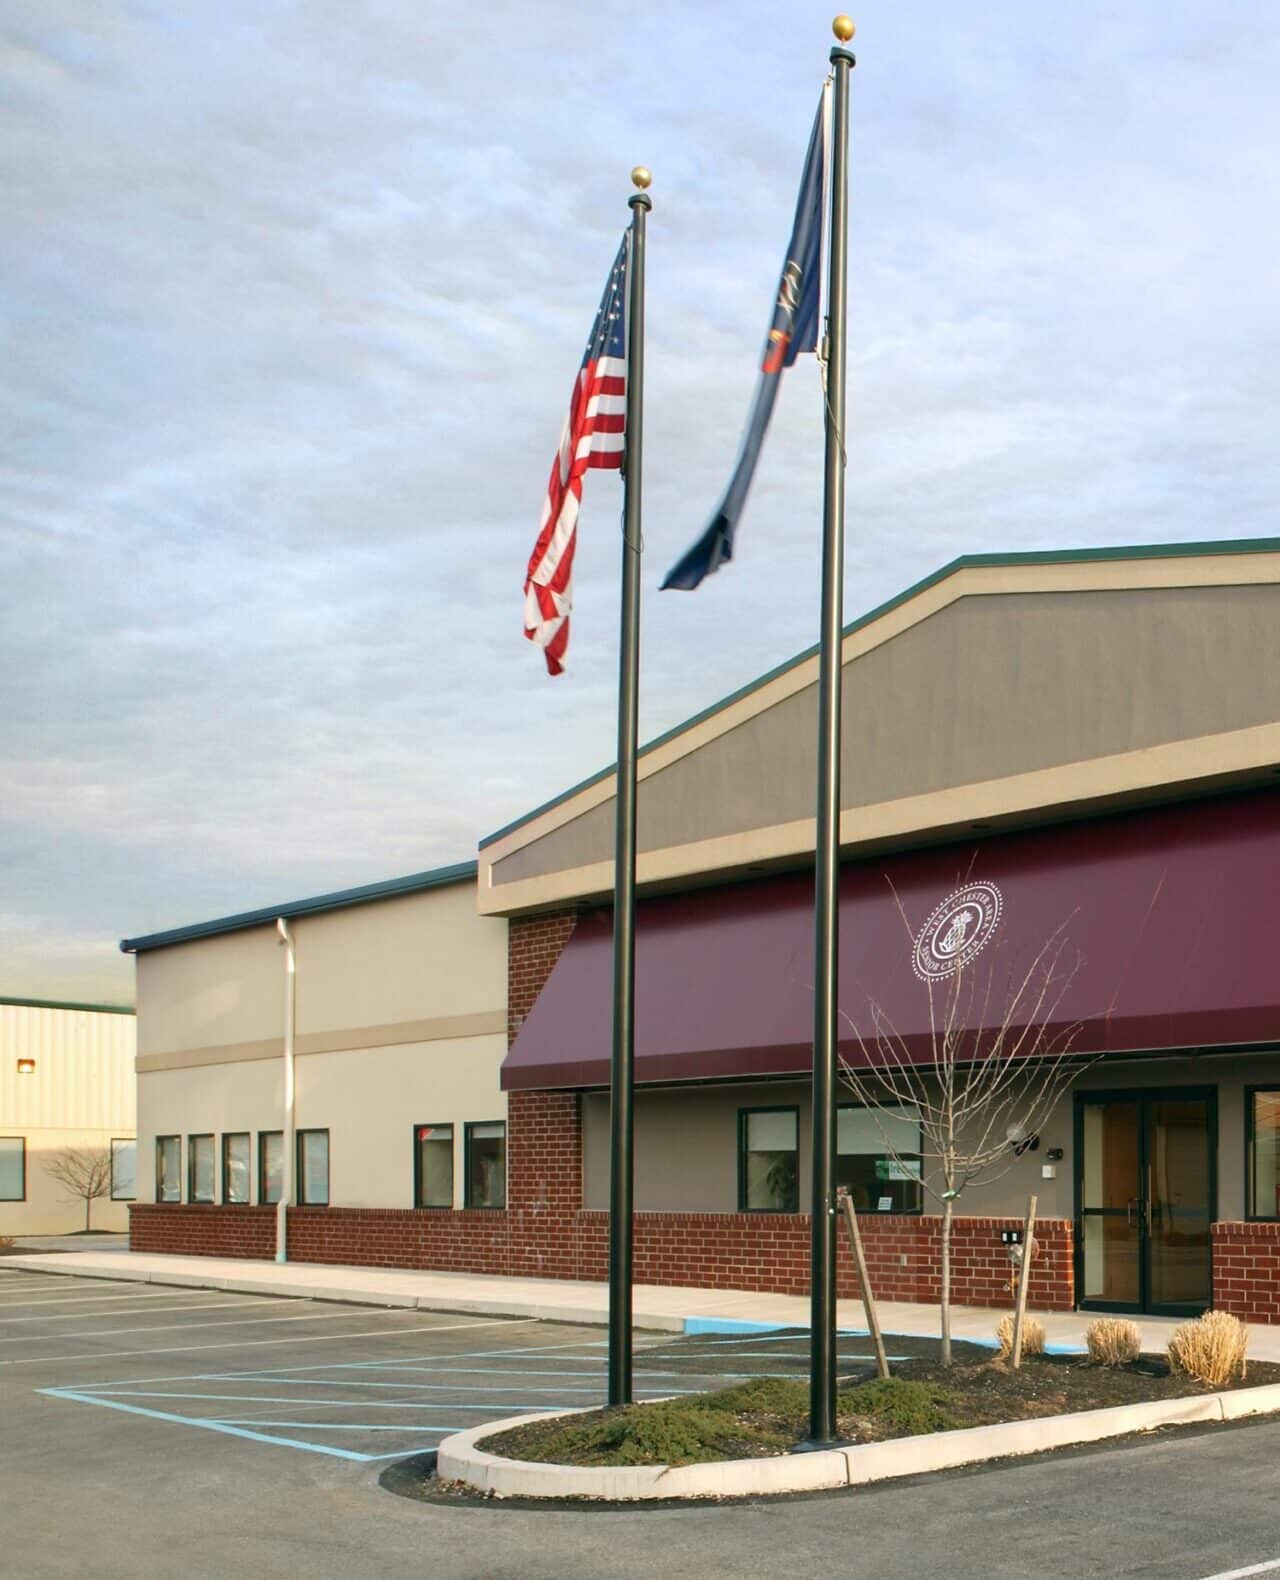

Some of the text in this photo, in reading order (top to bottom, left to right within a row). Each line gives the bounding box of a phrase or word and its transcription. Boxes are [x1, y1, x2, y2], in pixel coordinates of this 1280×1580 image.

[927, 892, 993, 936] WEST CHESTER AREA
[922, 945, 941, 971] SENIOR
